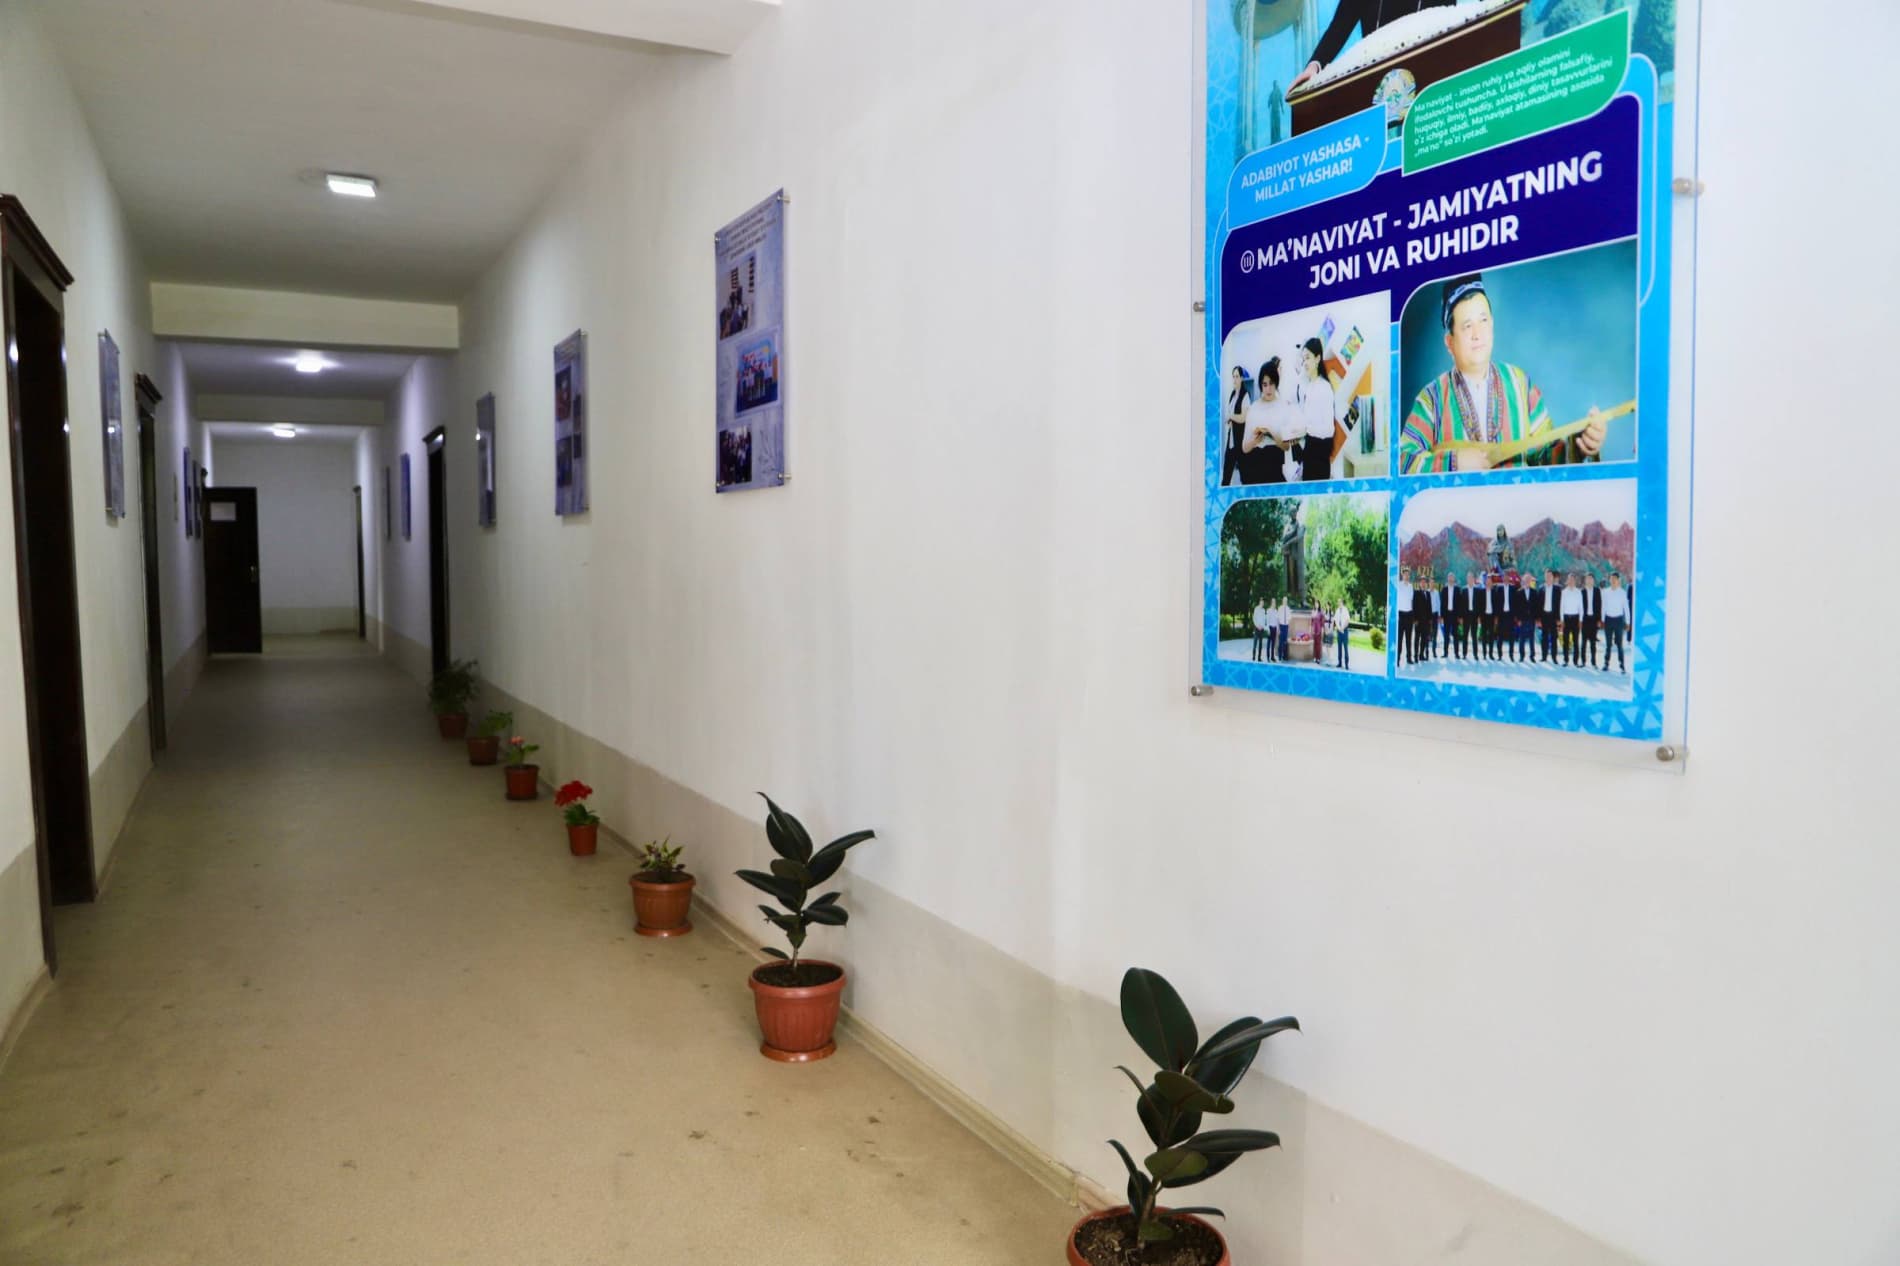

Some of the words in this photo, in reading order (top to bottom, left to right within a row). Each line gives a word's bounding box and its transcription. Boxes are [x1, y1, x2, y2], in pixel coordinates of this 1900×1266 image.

[1459, 83, 1481, 97] inson
[1482, 73, 1503, 89] ruhiy
[1515, 61, 1537, 77] aqliy
[1537, 46, 1571, 68] olamini
[1500, 83, 1507, 93] U
[1527, 79, 1550, 95] diniy
[1426, 127, 1449, 143] ichiga
[1569, 73, 1605, 92] asosida
[1241, 154, 1300, 190] ADABIYOT
[1302, 134, 1361, 168] YASHASA
[1255, 176, 1297, 204] MILLAT
[1299, 156, 1353, 189] YASHAR!
[1256, 211, 1388, 271] MA’NAVIYAT
[1407, 150, 1603, 231] JAMIYATNING
[1308, 254, 1361, 290] JONI
[1366, 245, 1401, 276] VA
[1406, 214, 1520, 267] RUHIDIR
